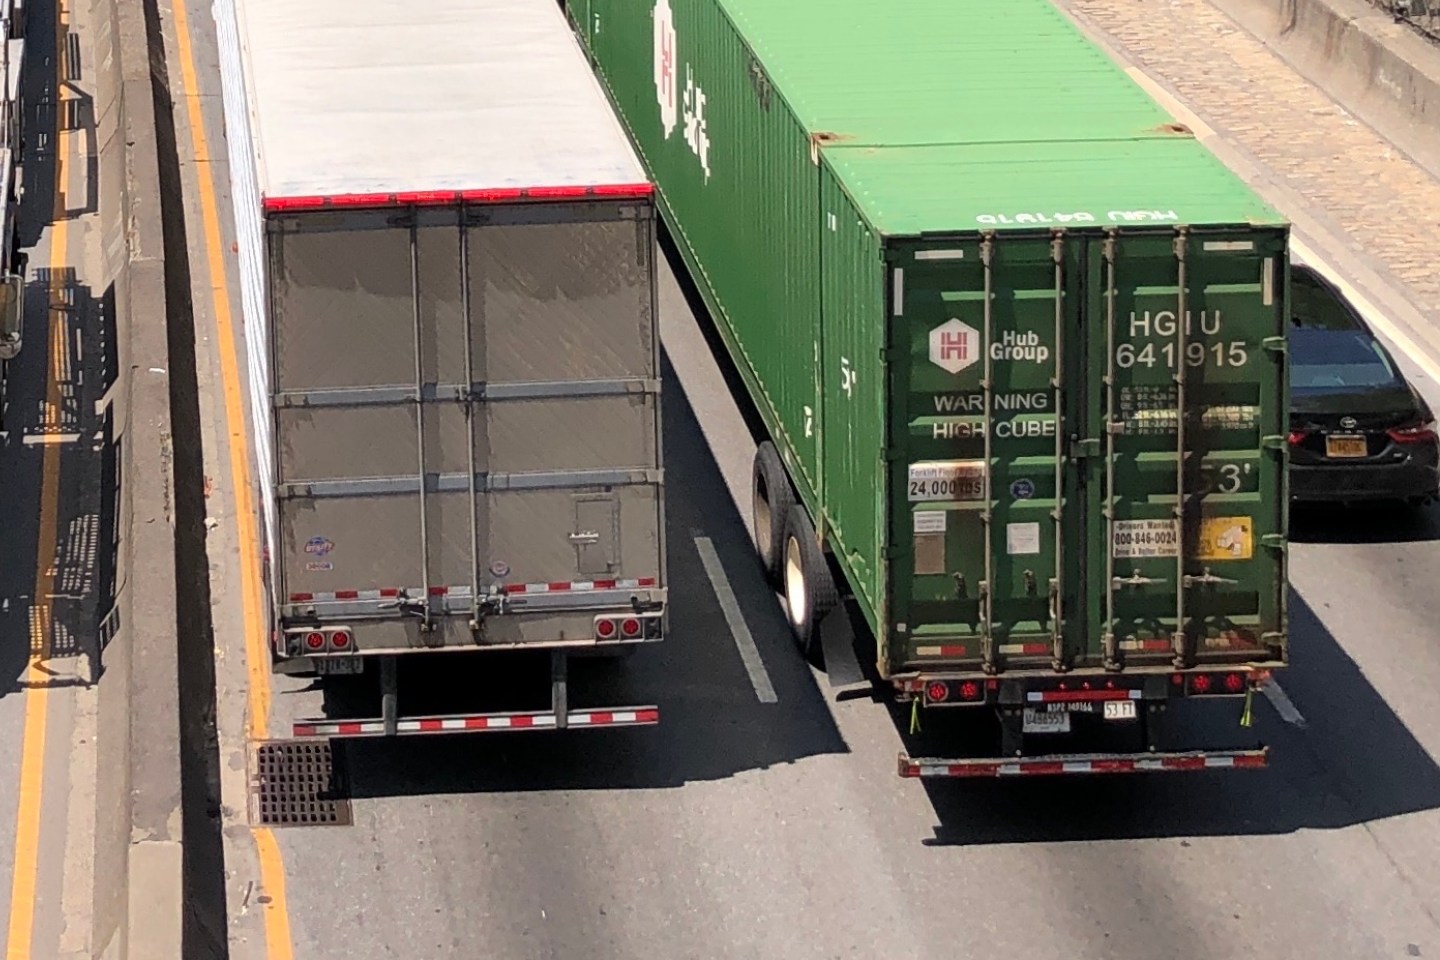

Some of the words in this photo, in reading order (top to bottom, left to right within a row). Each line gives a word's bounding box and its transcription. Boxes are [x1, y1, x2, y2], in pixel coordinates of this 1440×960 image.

[1130, 310, 1220, 336] HGIU
[1003, 330, 1039, 346] Hub
[990, 342, 1049, 364] Group
[1116, 341, 1247, 368] 641915
[933, 393, 1048, 412] WARNING
[933, 422, 985, 439] HIGH
[995, 420, 1056, 438] CUBE
[910, 480, 957, 498] 24,000
[1115, 531, 1177, 545] 800-846-0024
[1106, 703, 1118, 716] 53
[1122, 703, 1133, 715] FT
